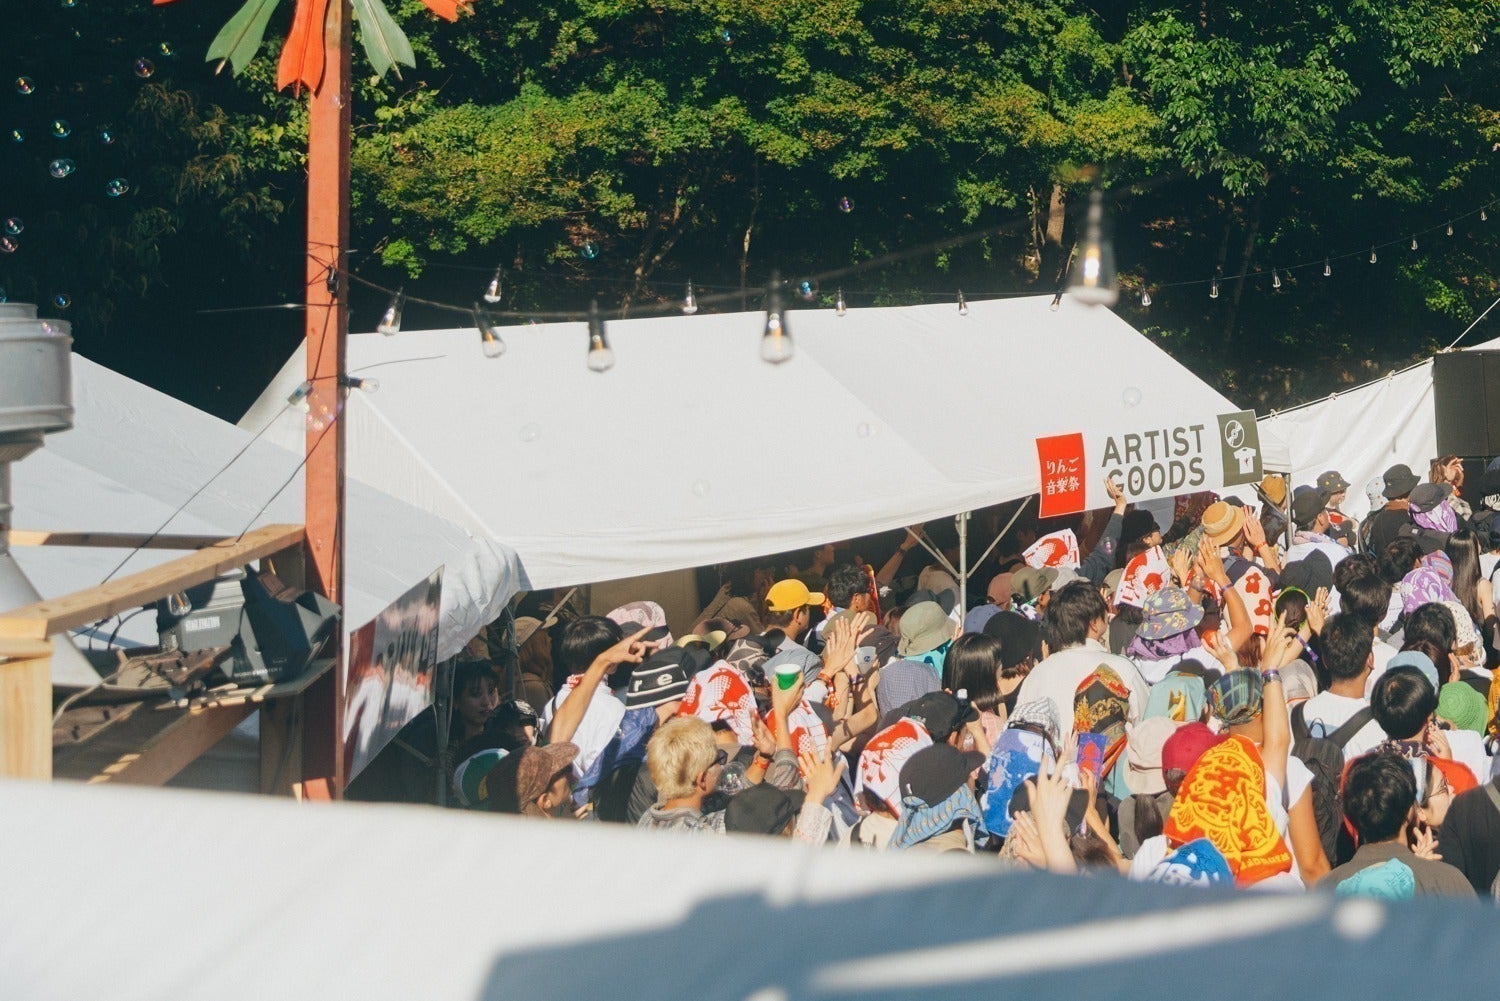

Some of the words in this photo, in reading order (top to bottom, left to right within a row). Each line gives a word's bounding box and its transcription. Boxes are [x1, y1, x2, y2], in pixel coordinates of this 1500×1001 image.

[1102, 424, 1204, 467] ARTIST
[1046, 457, 1080, 475] りんご
[1106, 457, 1205, 499] GOODS
[1045, 475, 1081, 495] 音楽祭
